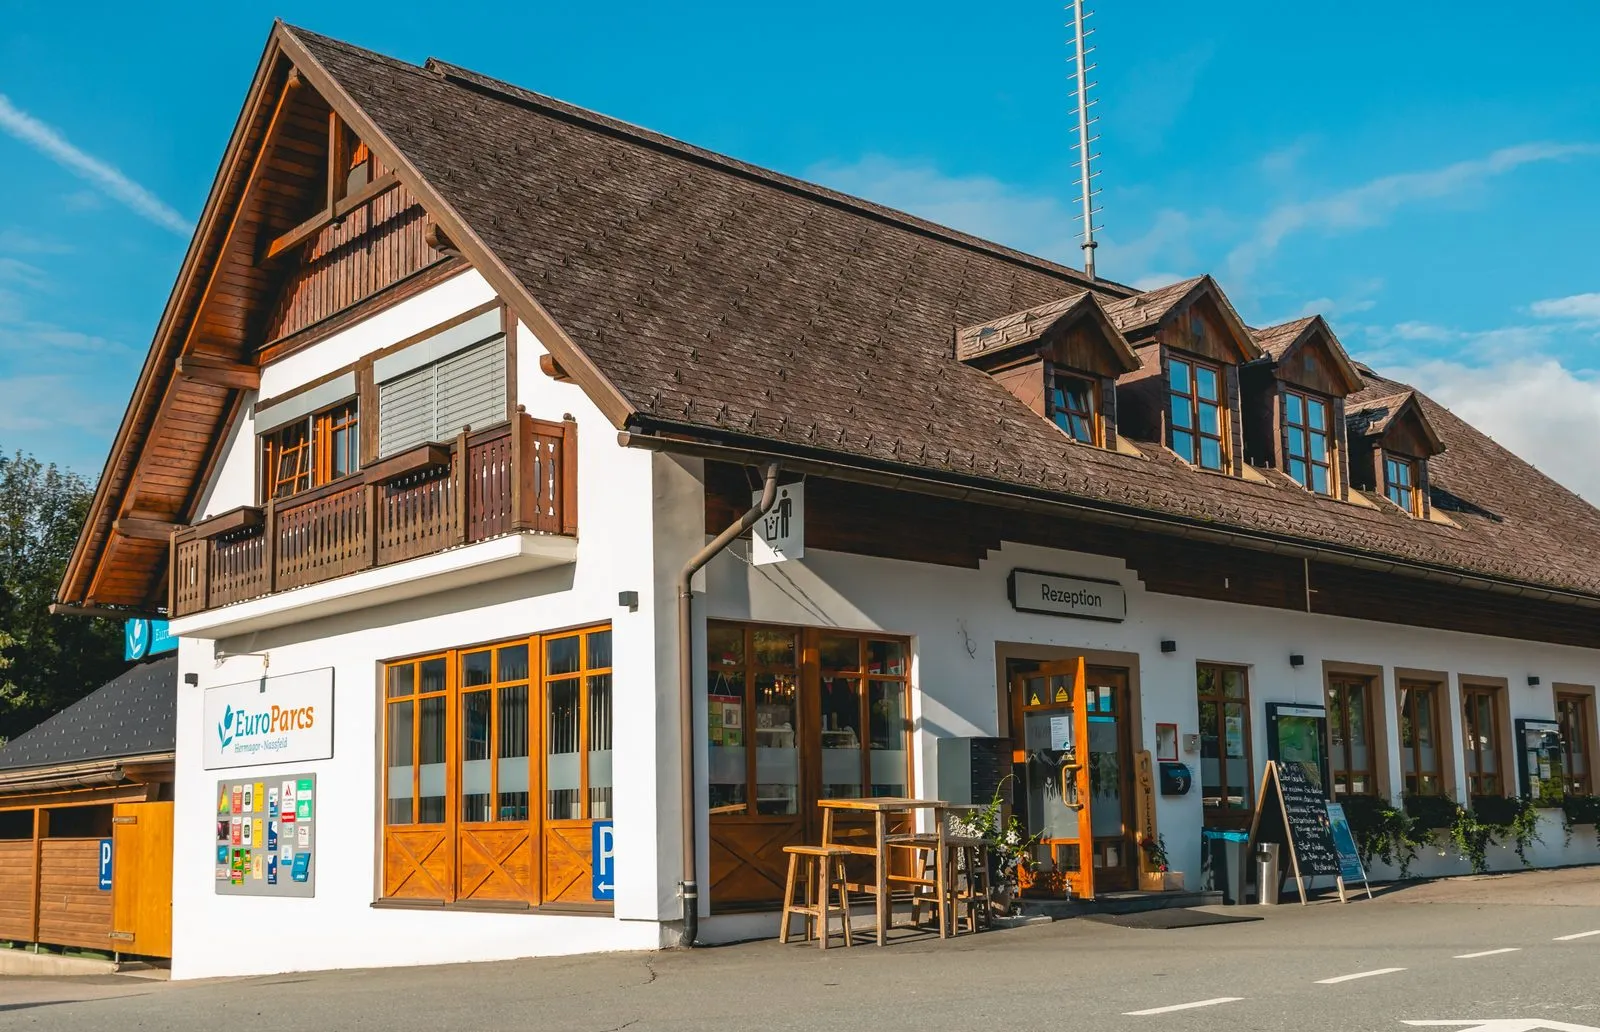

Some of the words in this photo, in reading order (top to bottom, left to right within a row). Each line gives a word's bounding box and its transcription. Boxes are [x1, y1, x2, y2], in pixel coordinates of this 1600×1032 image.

[1041, 583, 1102, 608] Rezeption
[235, 705, 314, 737] EuroParcs
[102, 843, 111, 875] P
[600, 826, 614, 875] P
